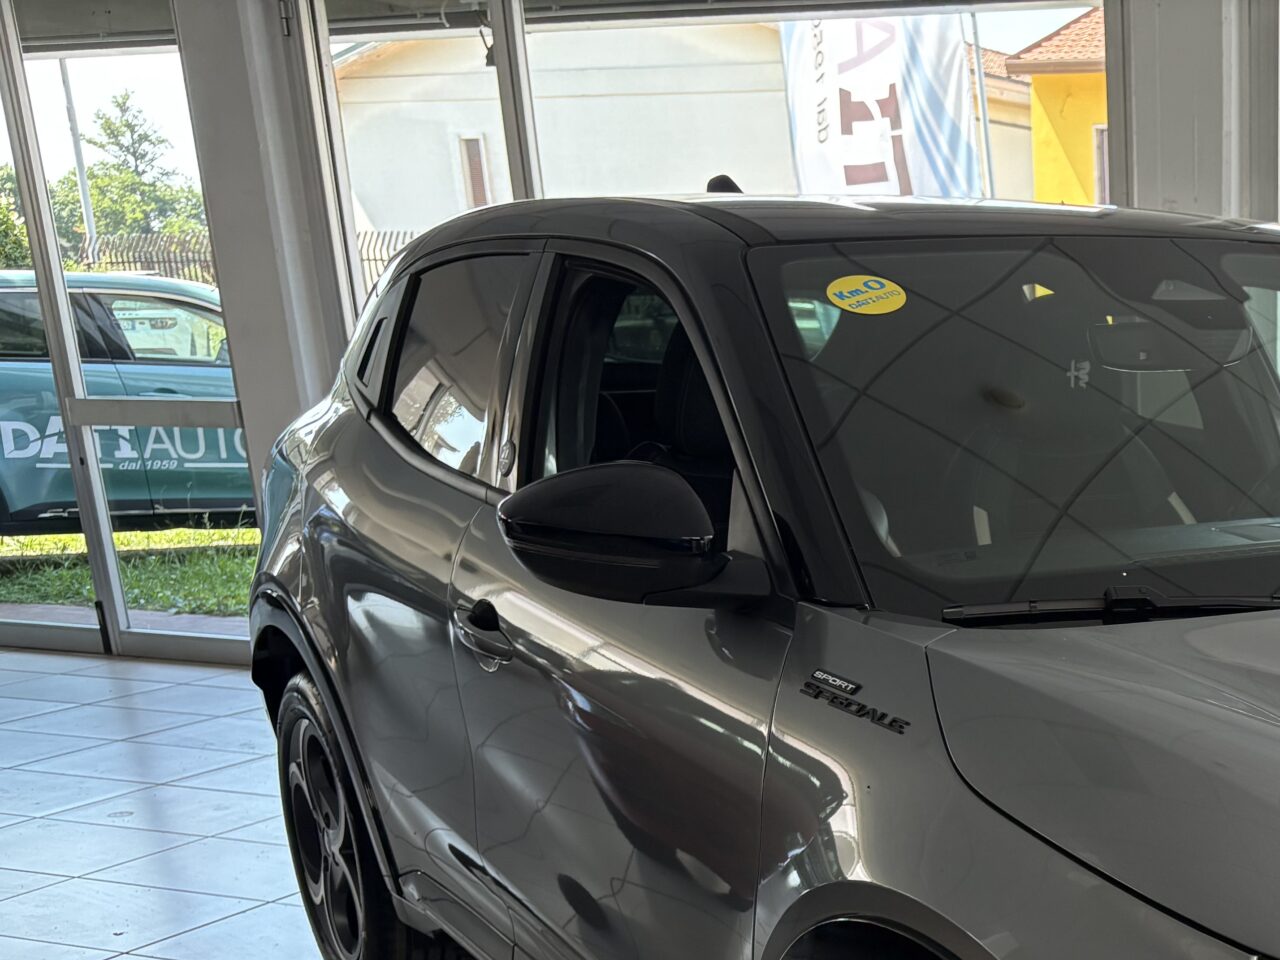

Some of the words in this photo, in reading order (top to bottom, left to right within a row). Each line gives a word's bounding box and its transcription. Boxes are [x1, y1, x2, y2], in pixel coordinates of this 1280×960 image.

[145, 459, 178, 470] 1959
[813, 670, 856, 691] SPORT
[799, 681, 911, 735] SPECIALE
